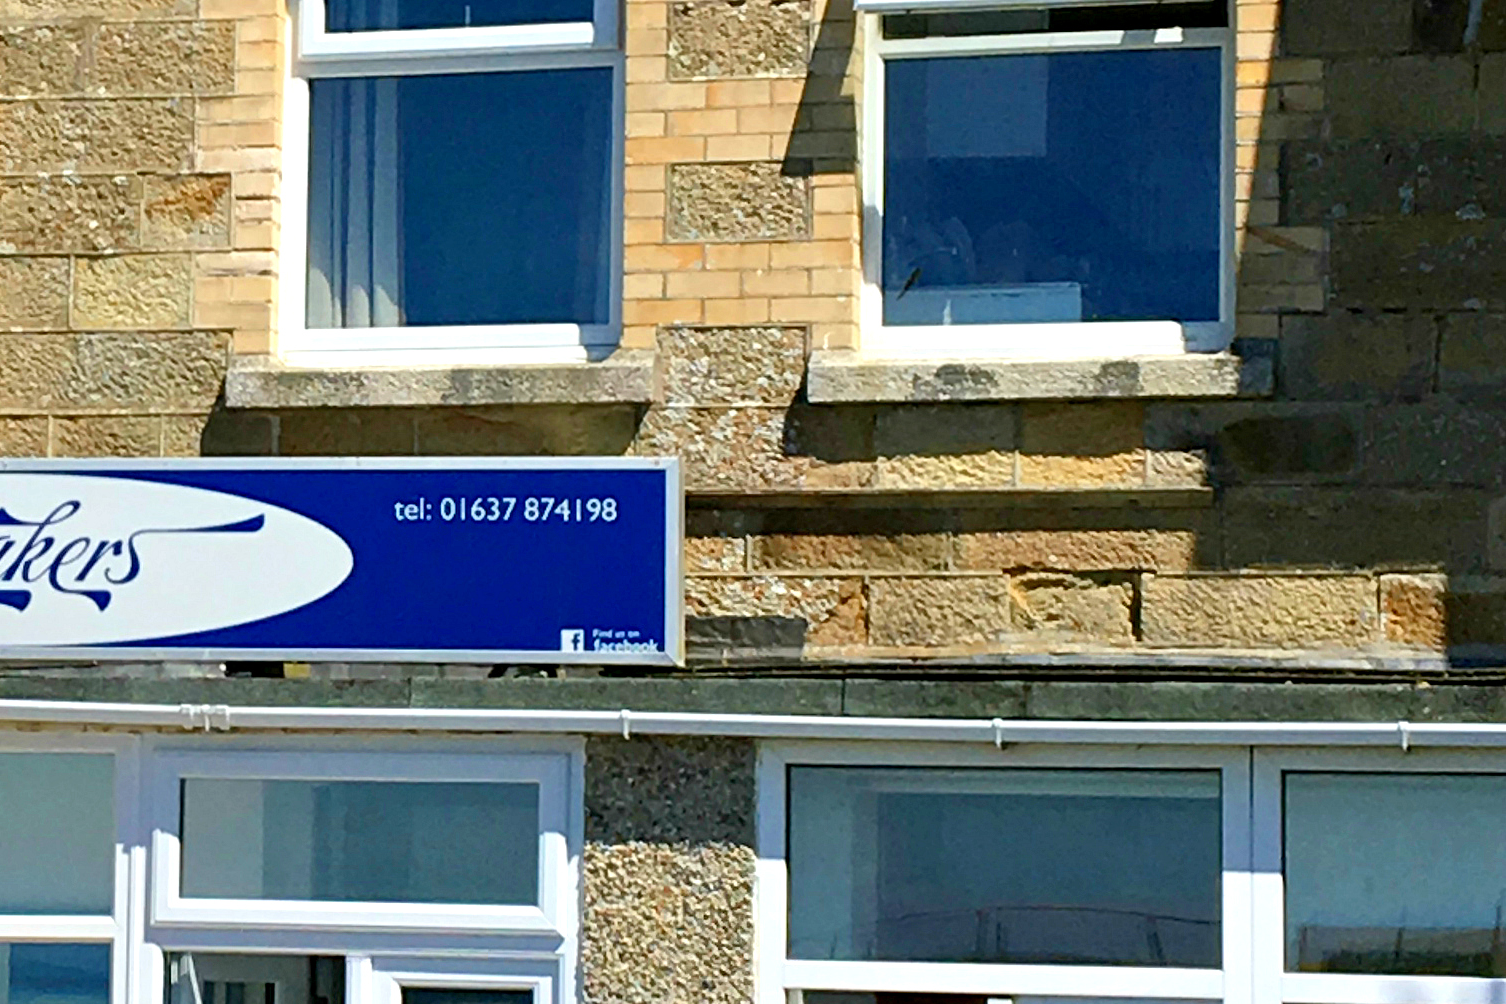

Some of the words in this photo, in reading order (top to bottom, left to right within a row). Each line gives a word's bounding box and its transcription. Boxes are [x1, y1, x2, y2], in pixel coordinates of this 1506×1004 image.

[394, 498, 432, 521] tel:
[440, 497, 517, 521] 01637
[523, 497, 618, 522] 874198
[593, 638, 659, 653] facebook
